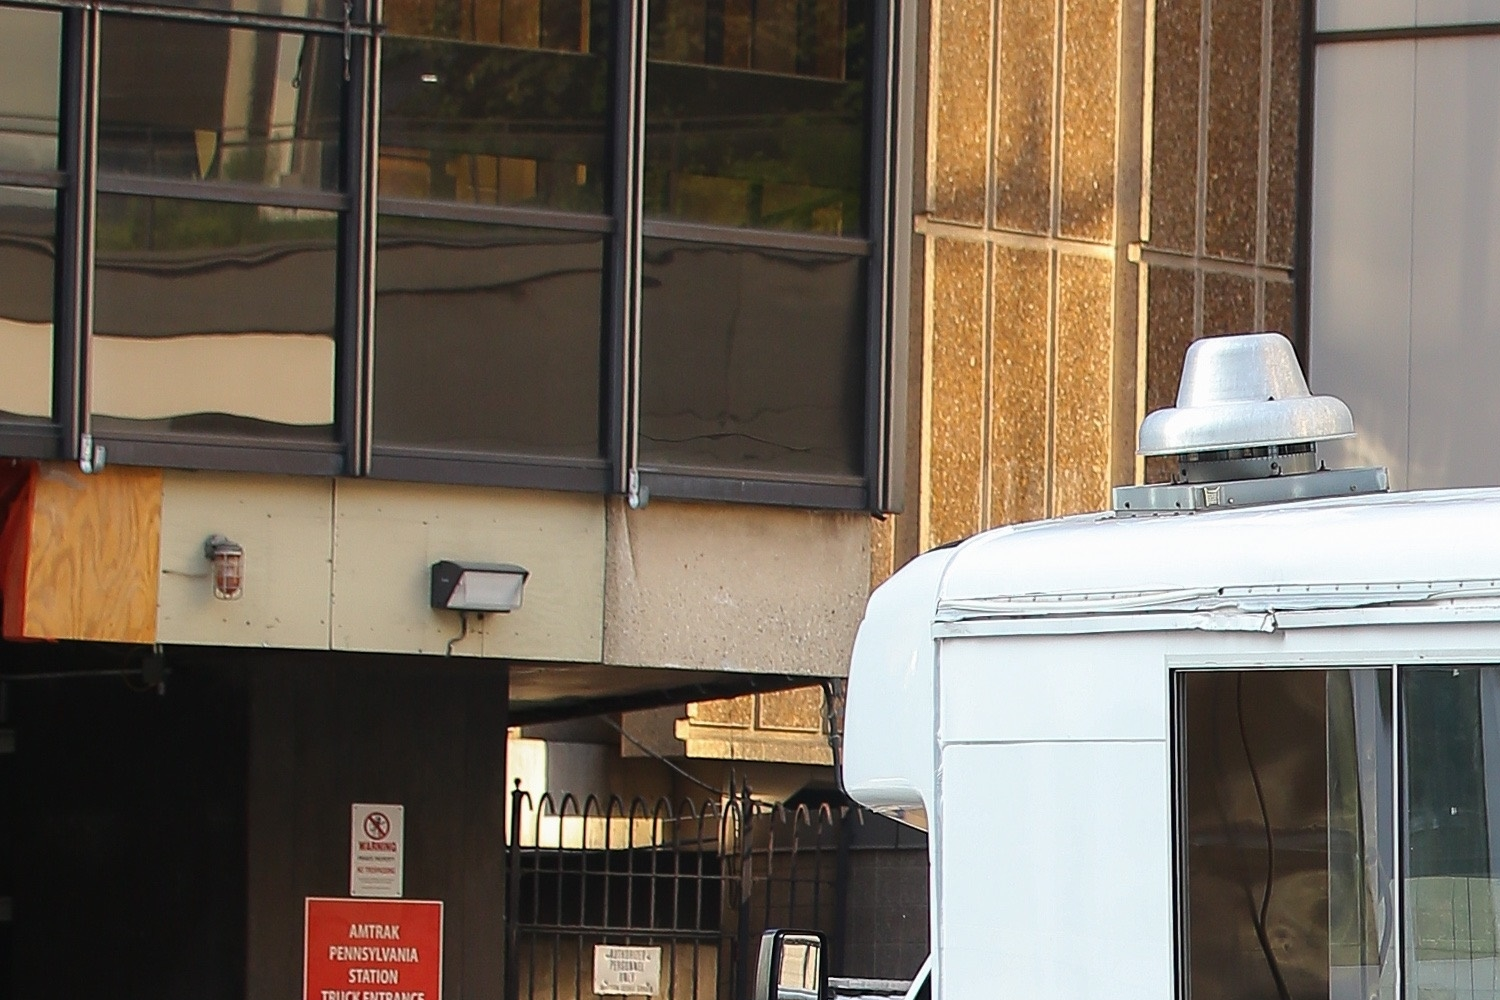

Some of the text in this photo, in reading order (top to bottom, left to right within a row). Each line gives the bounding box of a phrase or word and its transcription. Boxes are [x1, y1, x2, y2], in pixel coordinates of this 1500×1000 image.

[349, 924, 400, 940] AMTRAK
[329, 945, 419, 963] PENNSYLVANIA
[348, 969, 399, 985] STATION
